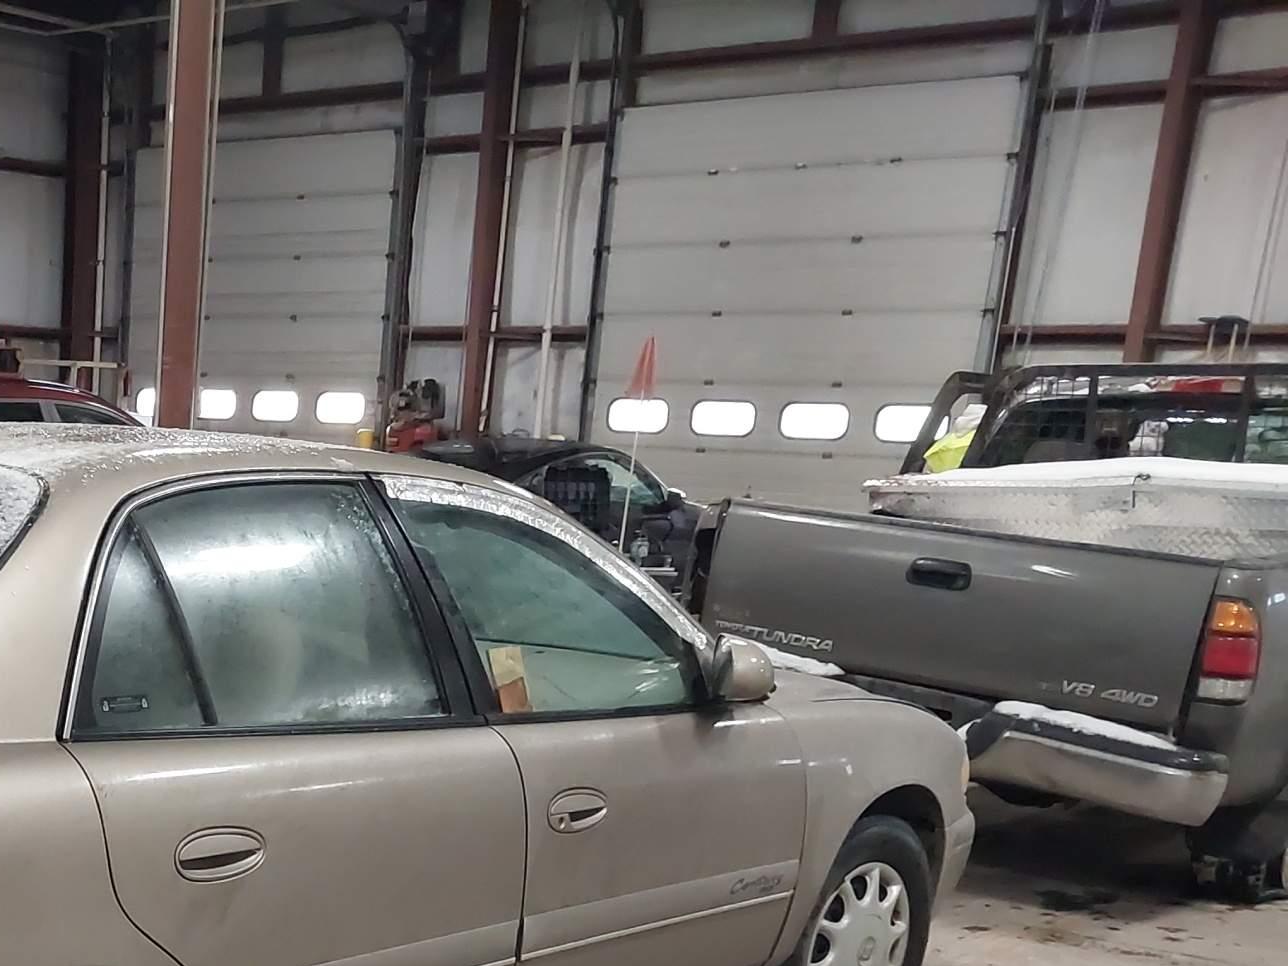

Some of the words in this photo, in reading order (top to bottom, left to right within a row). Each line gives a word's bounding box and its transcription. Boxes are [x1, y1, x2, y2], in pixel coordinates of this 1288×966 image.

[746, 626, 833, 652] TUNDRA
[1062, 680, 1095, 697] V8
[1100, 689, 1158, 707] 4WD
